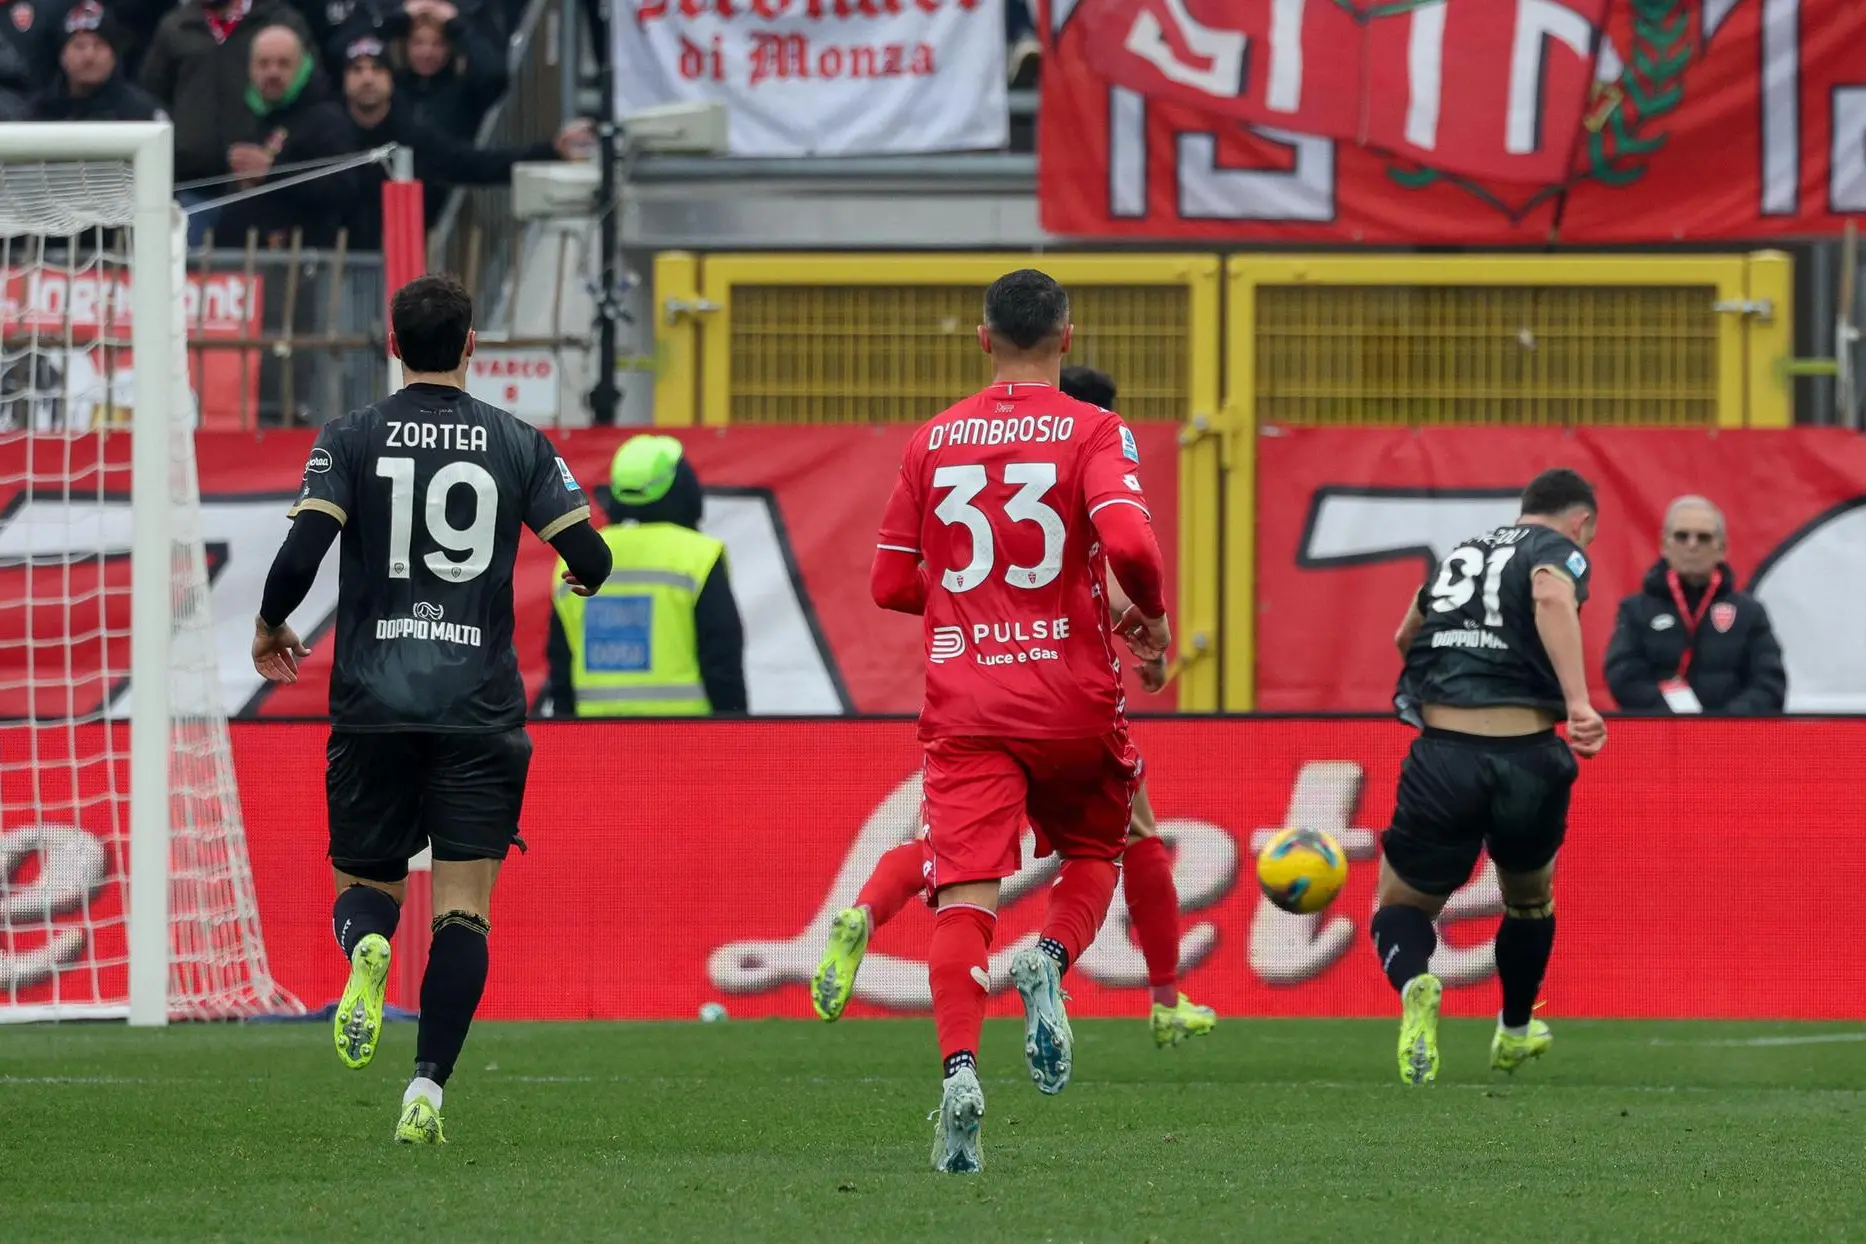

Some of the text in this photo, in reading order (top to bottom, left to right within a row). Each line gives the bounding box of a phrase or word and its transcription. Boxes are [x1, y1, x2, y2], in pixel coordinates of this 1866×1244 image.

[679, 30, 937, 86] di Monza
[474, 359, 552, 379] VARCO
[385, 421, 488, 452] ZORTEA
[928, 414, 1075, 451] D'AMBROSIO
[375, 456, 499, 583] 19
[932, 462, 1067, 593] 33
[1431, 546, 1517, 628] 91
[376, 617, 482, 647] DOPPIO MALTO
[976, 647, 1059, 666] Luce e Gas
